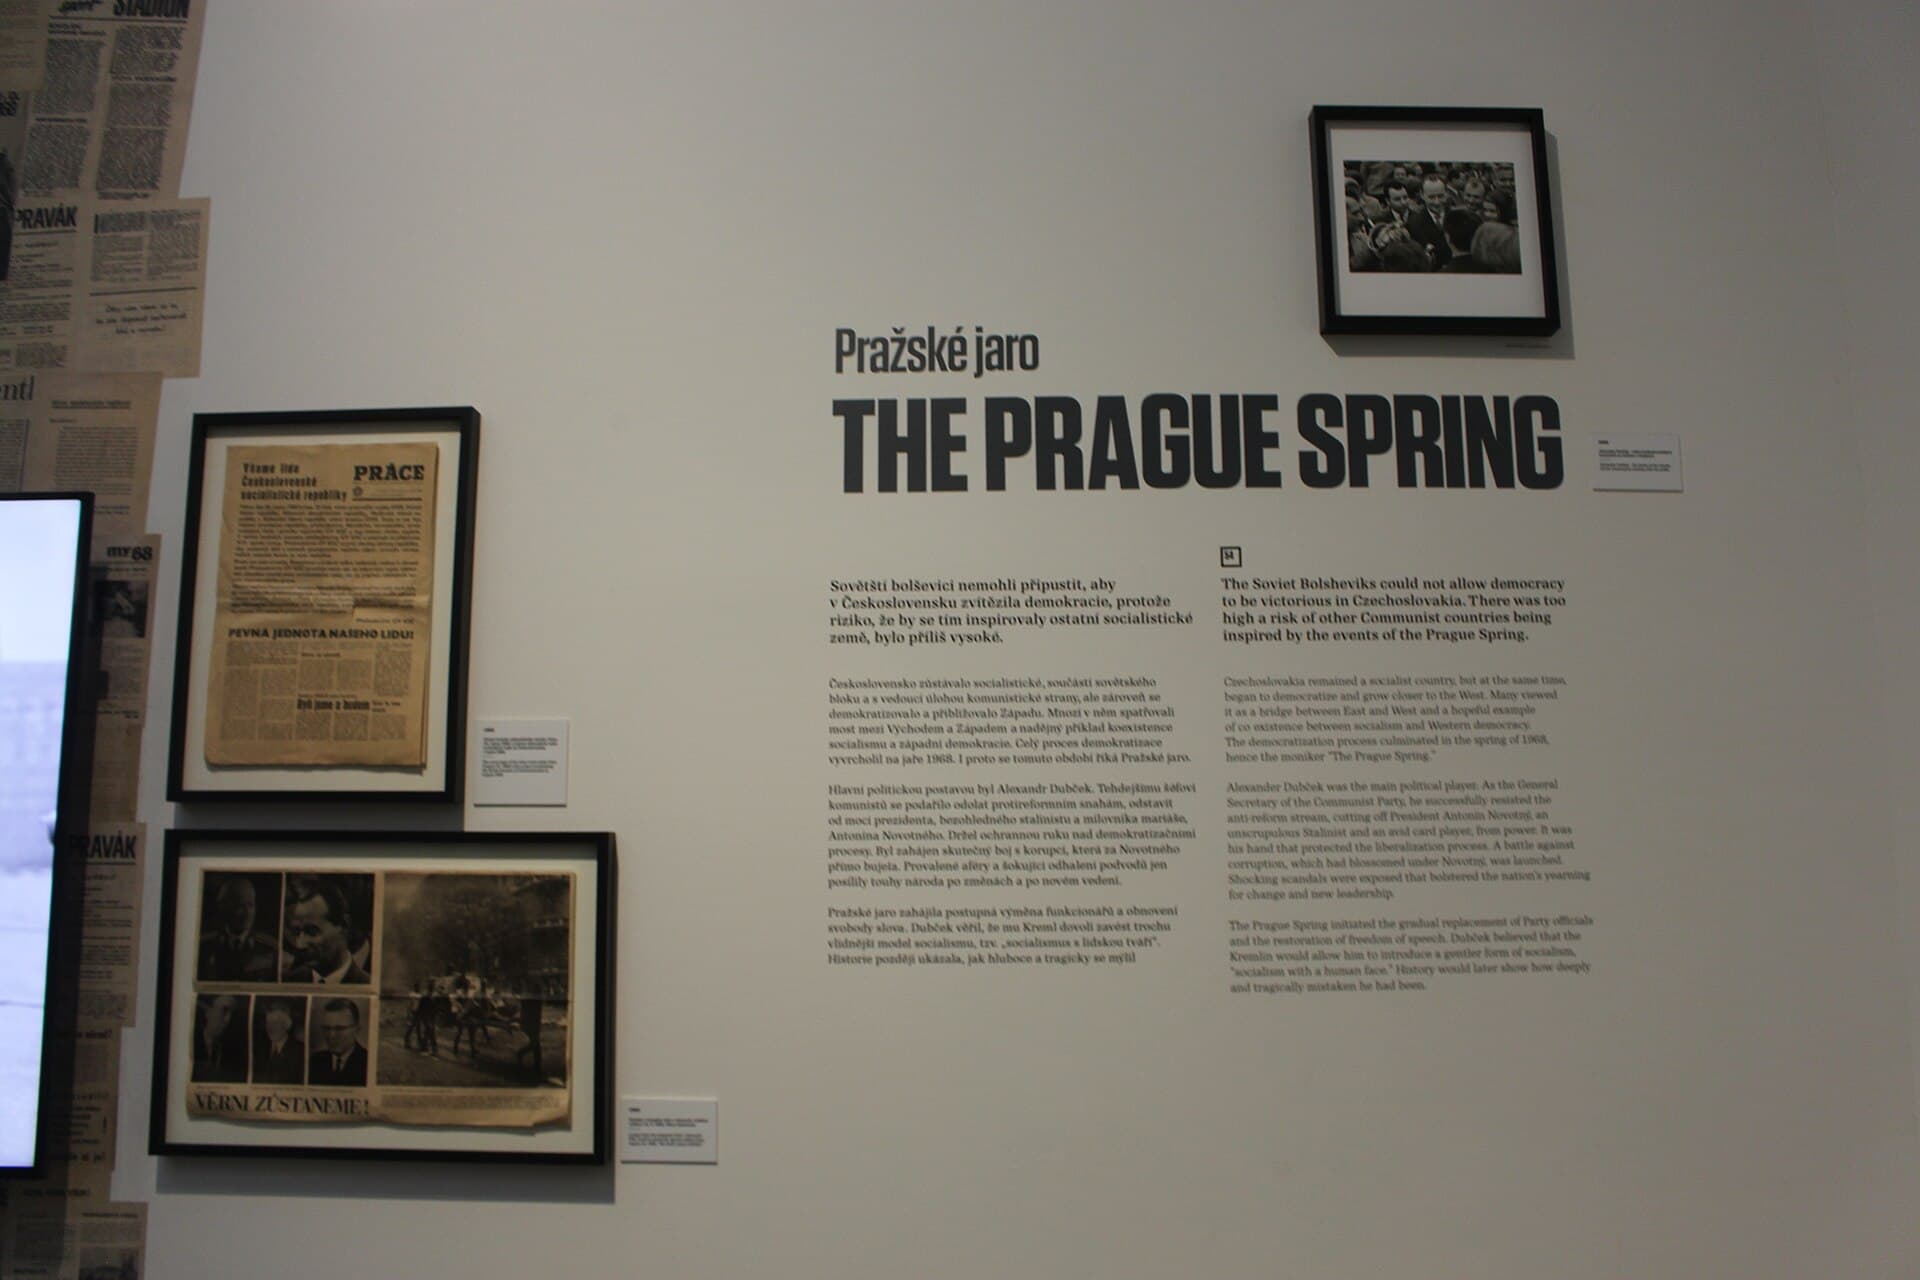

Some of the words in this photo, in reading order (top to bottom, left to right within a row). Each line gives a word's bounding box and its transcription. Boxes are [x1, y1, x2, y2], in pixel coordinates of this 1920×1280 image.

[835, 327, 967, 374] Pražské
[973, 327, 1039, 378] jaro
[832, 398, 969, 493] THE
[984, 394, 1282, 492] PRAGUE
[1296, 393, 1565, 490] SPRING
[353, 463, 424, 482] PRÁCE
[830, 578, 887, 593] Sovětští
[891, 578, 954, 592] bolševici
[958, 577, 1016, 592] nemohli
[1020, 577, 1086, 595] připustit,
[1090, 576, 1115, 595] aby
[1220, 576, 1248, 590] The
[1251, 576, 1295, 591] Soviet
[1299, 576, 1376, 591] Bolsheviks
[1379, 576, 1418, 591] could
[1422, 576, 1445, 591] not
[1449, 576, 1486, 591] allow
[1490, 576, 1564, 594] democracy
[829, 598, 838, 609] v
[841, 591, 956, 609] Československu
[960, 594, 1022, 609] zvítězila
[1021, 594, 1112, 611] demokracie,
[1116, 593, 1170, 612] protože
[1221, 593, 1236, 607] to
[1239, 593, 1257, 607] be
[1260, 593, 1332, 607] victorious
[1335, 593, 1349, 607] in
[1352, 593, 1466, 607] Czechoslovakia.
[1467, 593, 1510, 607] There
[1513, 596, 1540, 607] was
[1543, 593, 1566, 607] too
[830, 612, 875, 629] riziko,
[878, 612, 894, 626] že
[898, 612, 915, 630] by
[919, 615, 934, 626] se
[938, 611, 962, 626] tím
[966, 611, 1046, 630] inspirovaly
[1049, 611, 1099, 626] ostatní
[1103, 611, 1192, 625] socialistické
[1222, 610, 1254, 629] high
[1258, 614, 1266, 625] a
[1270, 610, 1298, 625] risk
[1301, 610, 1316, 625] of
[1318, 610, 1357, 625] other
[1360, 610, 1440, 625] Communist
[1444, 610, 1510, 625] countries
[1512, 610, 1552, 628] being
[829, 629, 870, 646] země,
[872, 629, 904, 648] bylo
[907, 629, 946, 647] příliš
[949, 629, 1003, 647] vysoké.
[1223, 628, 1282, 646] inspired
[1285, 627, 1302, 646] by
[1305, 627, 1329, 642] the
[1332, 627, 1379, 642] events
[1381, 627, 1396, 642] of
[1399, 627, 1422, 642] the
[1425, 627, 1475, 645] Prague
[1478, 627, 1528, 645] Spring.
